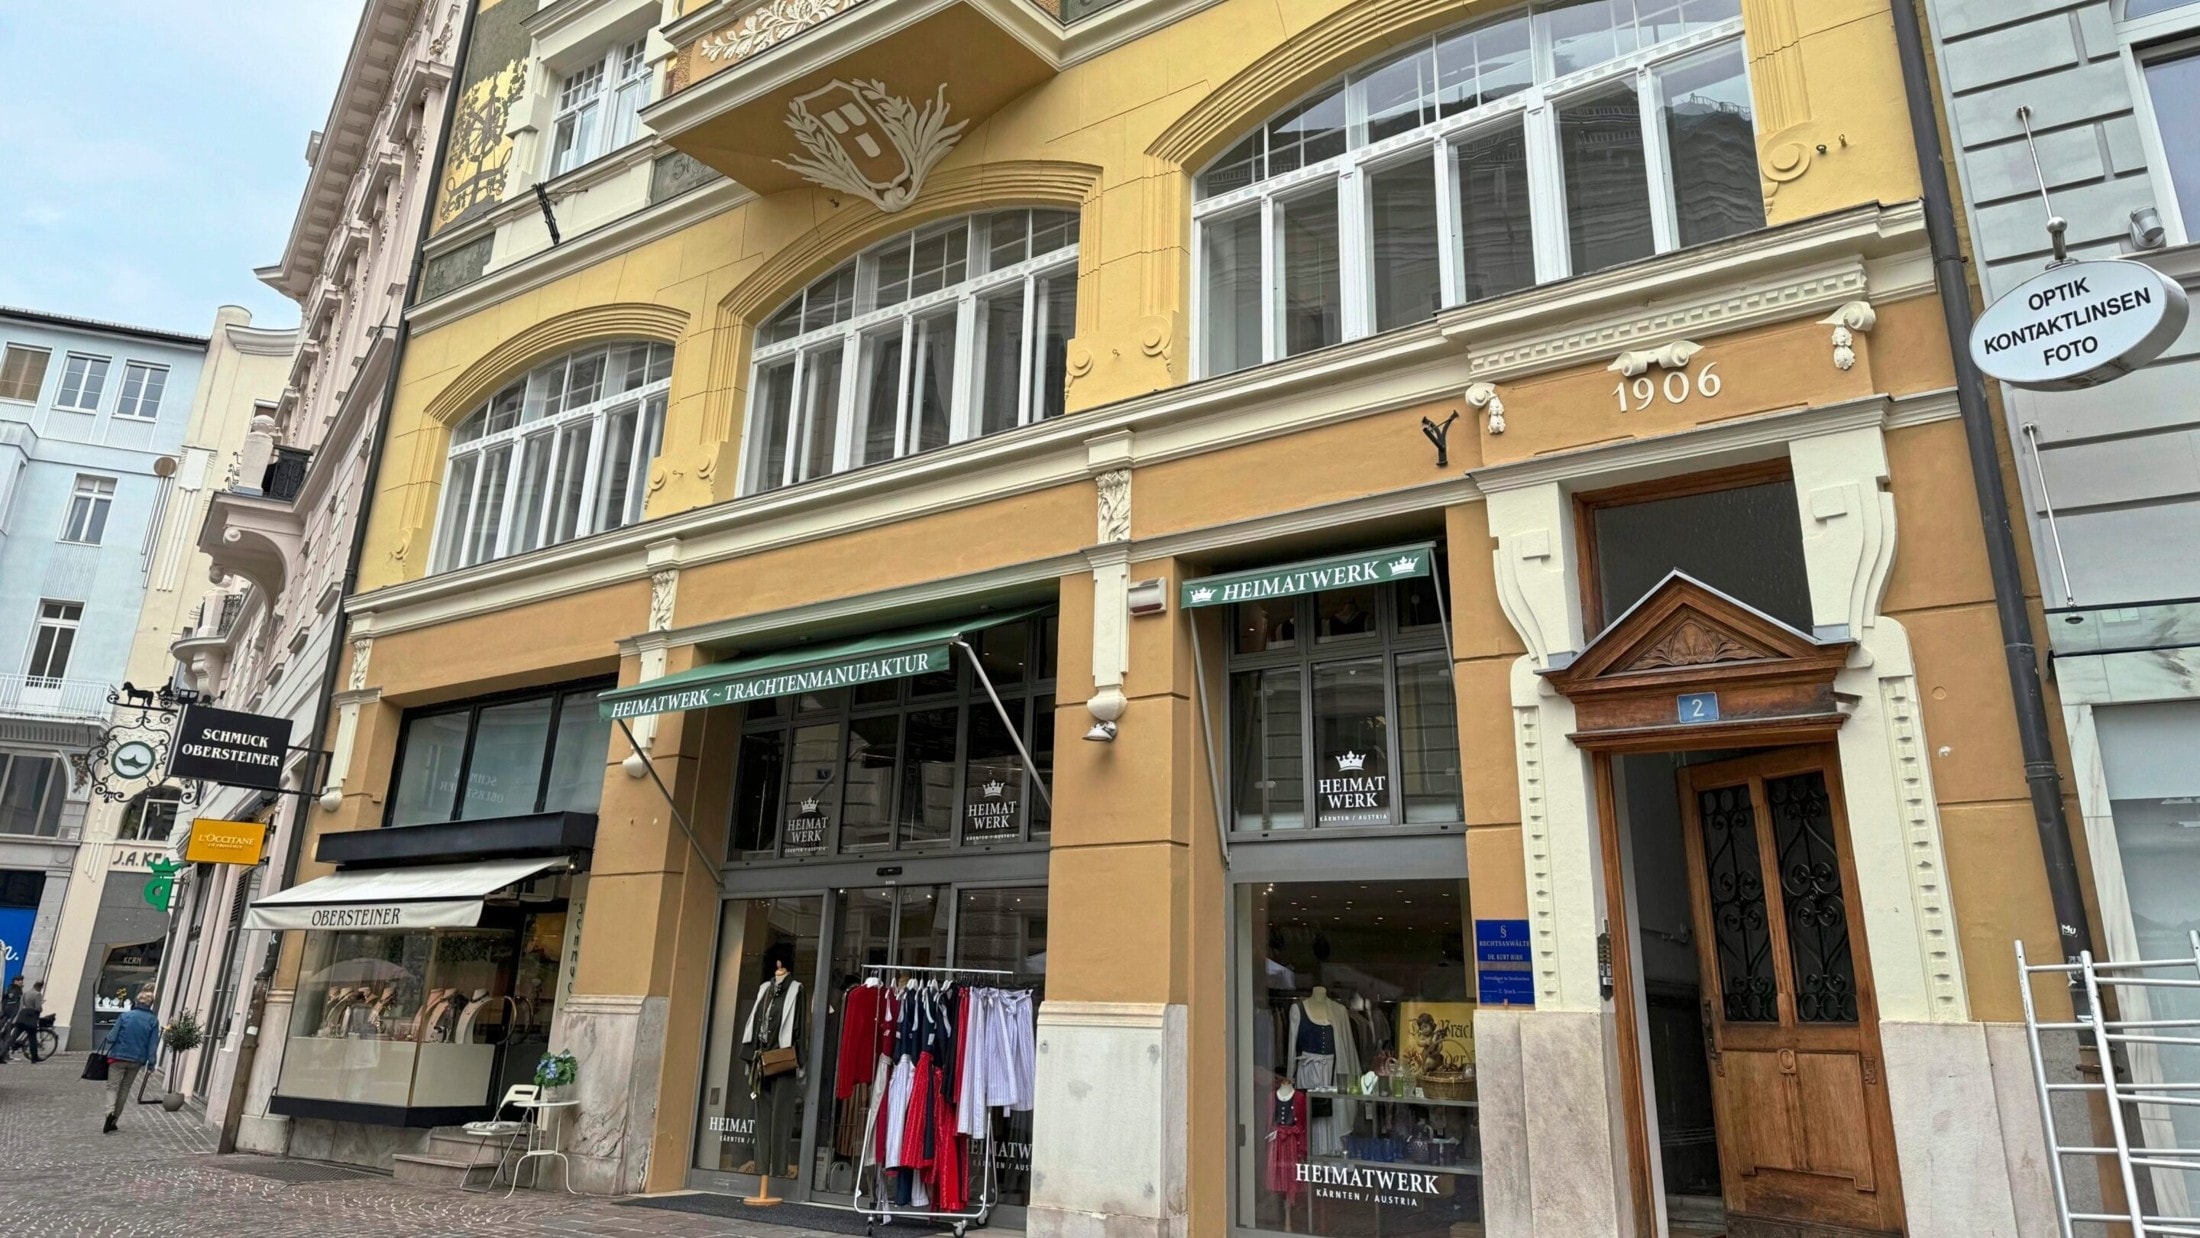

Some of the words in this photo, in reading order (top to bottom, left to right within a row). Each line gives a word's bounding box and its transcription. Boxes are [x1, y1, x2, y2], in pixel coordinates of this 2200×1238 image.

[2028, 277, 2091, 311] OPTIK
[1984, 287, 2151, 354] KONTAKTLINSEN
[2043, 336, 2098, 366] FOTO
[1611, 361, 1721, 413] 1906
[1223, 560, 1380, 601] HEIMATWERK
[611, 687, 709, 718] HEIMATWERK
[724, 652, 929, 701] TRACHTENMANUFAKTUR
[1691, 698, 1705, 717] 2
[201, 728, 269, 748] SCHMUCK
[181, 743, 280, 767] OBERSTEINER
[1319, 775, 1386, 794] HEIMAT
[968, 801, 1017, 817] HEIMAT
[1327, 792, 1378, 809] WERK
[787, 816, 829, 831] HEIMAT
[974, 815, 1010, 830] WERK
[791, 830, 822, 843] WERK
[141, 852, 163, 867] KE
[311, 908, 401, 926] OBERSTEINER
[709, 1117, 756, 1134] HEIMAT
[1295, 1163, 1440, 1195] HEIMATWERK
[1316, 1188, 1360, 1200] KÄRNTEN
[1374, 1195, 1418, 1207] AUSTRIA
